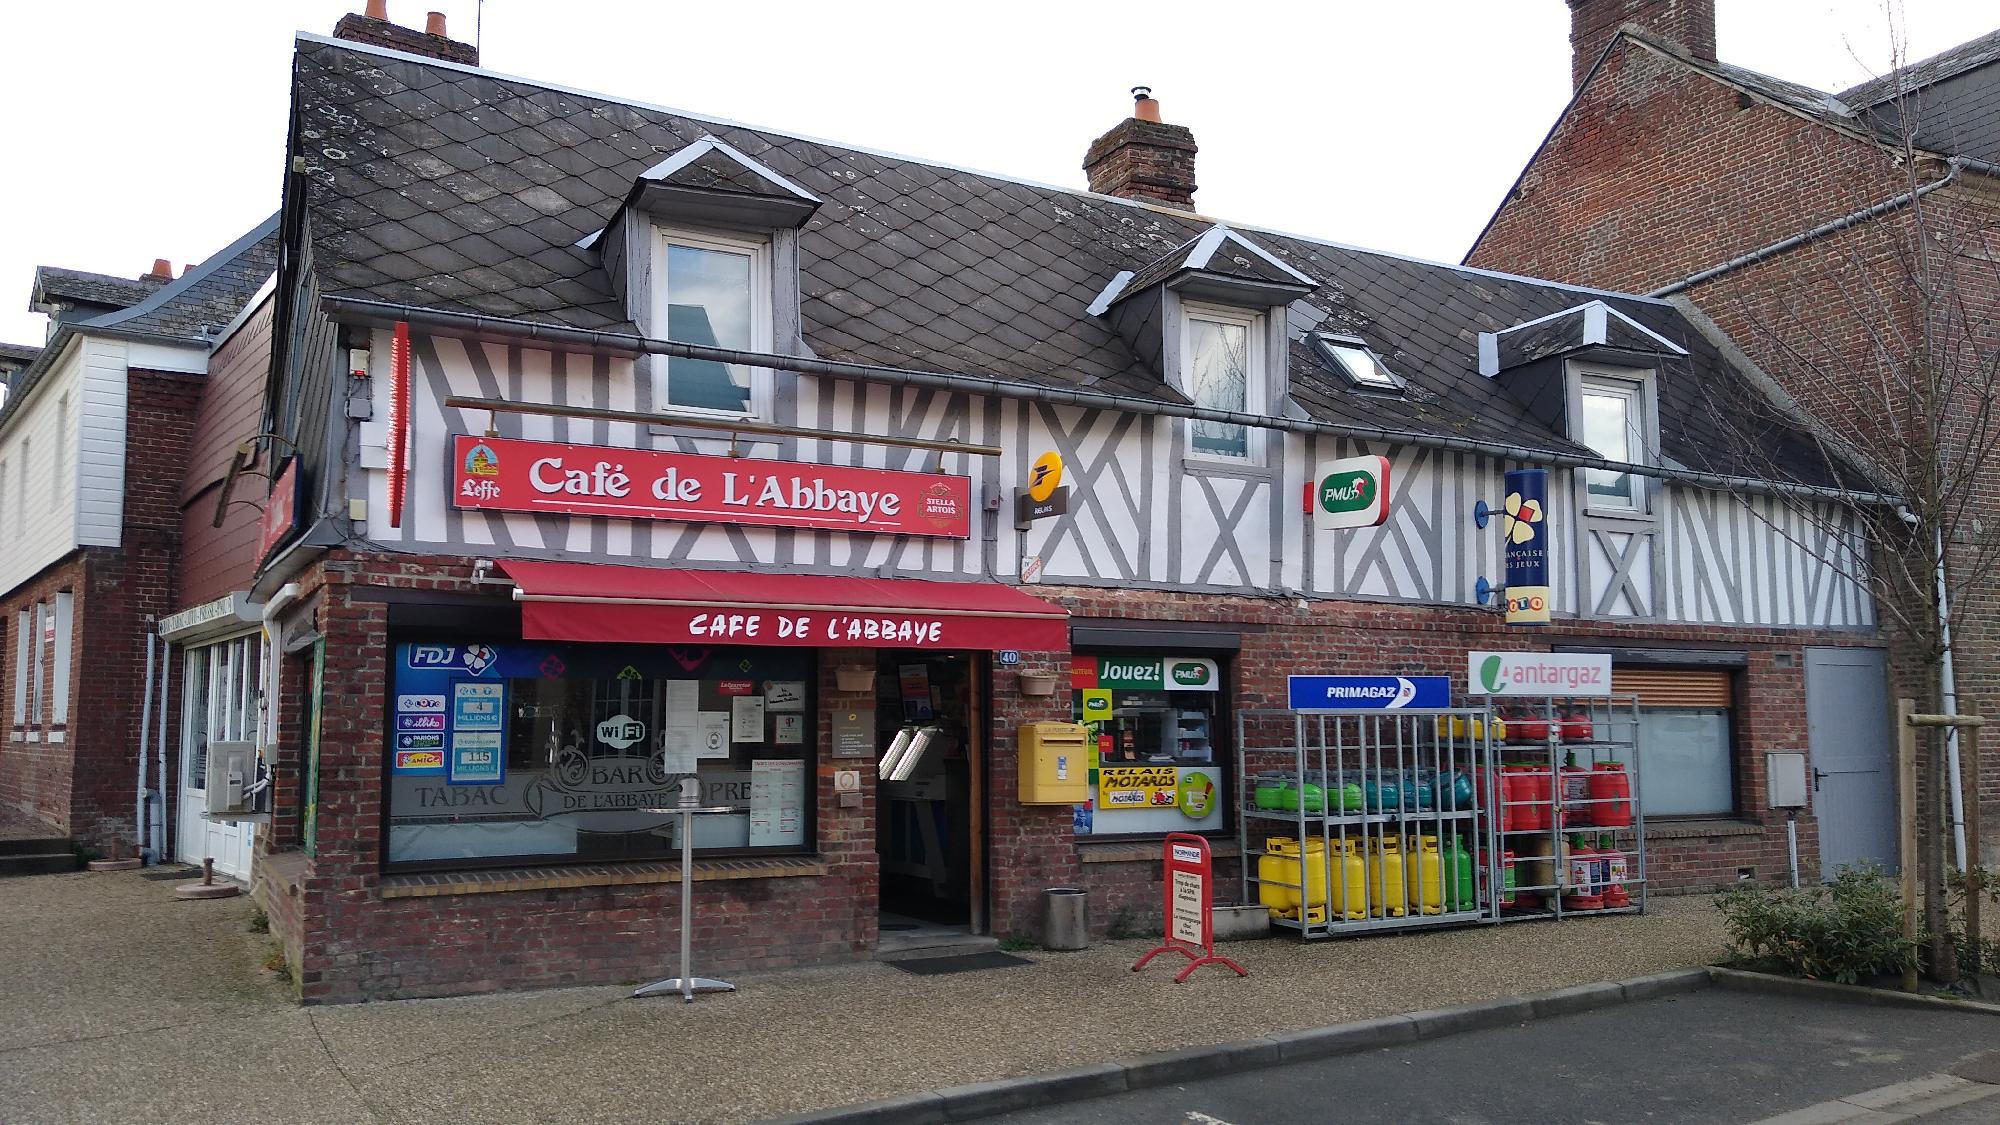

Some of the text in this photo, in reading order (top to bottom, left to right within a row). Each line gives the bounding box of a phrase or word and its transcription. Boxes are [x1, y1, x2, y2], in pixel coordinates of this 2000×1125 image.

[460, 478, 500, 501] Leffe
[529, 457, 900, 522] Café de L'Abbaye
[1325, 486, 1352, 502] PMU
[927, 498, 956, 506] STELLA
[927, 505, 956, 514] ARTOIS
[1505, 549, 1543, 559] ANÇAISE
[1516, 560, 1540, 569] JEUX
[1505, 596, 1544, 613] OTO
[689, 613, 943, 645] CAFE DE L'ABBAYE
[414, 647, 455, 664] FDJ
[1002, 651, 1017, 663] 40
[1101, 661, 1160, 681] Jouez!
[1175, 670, 1196, 679] PMU
[1513, 663, 1601, 689] antargaz
[1327, 687, 1396, 698] PRIMAGAZ
[412, 754, 441, 764] AMIGO
[469, 752, 490, 762] 115
[591, 766, 645, 785] BAR
[1103, 768, 1174, 776] RELAIS
[1104, 776, 1176, 788] MOTARDS
[415, 786, 510, 807] TABAC
[709, 782, 752, 801] PRE
[563, 792, 669, 809] DE L'ABBAYE
